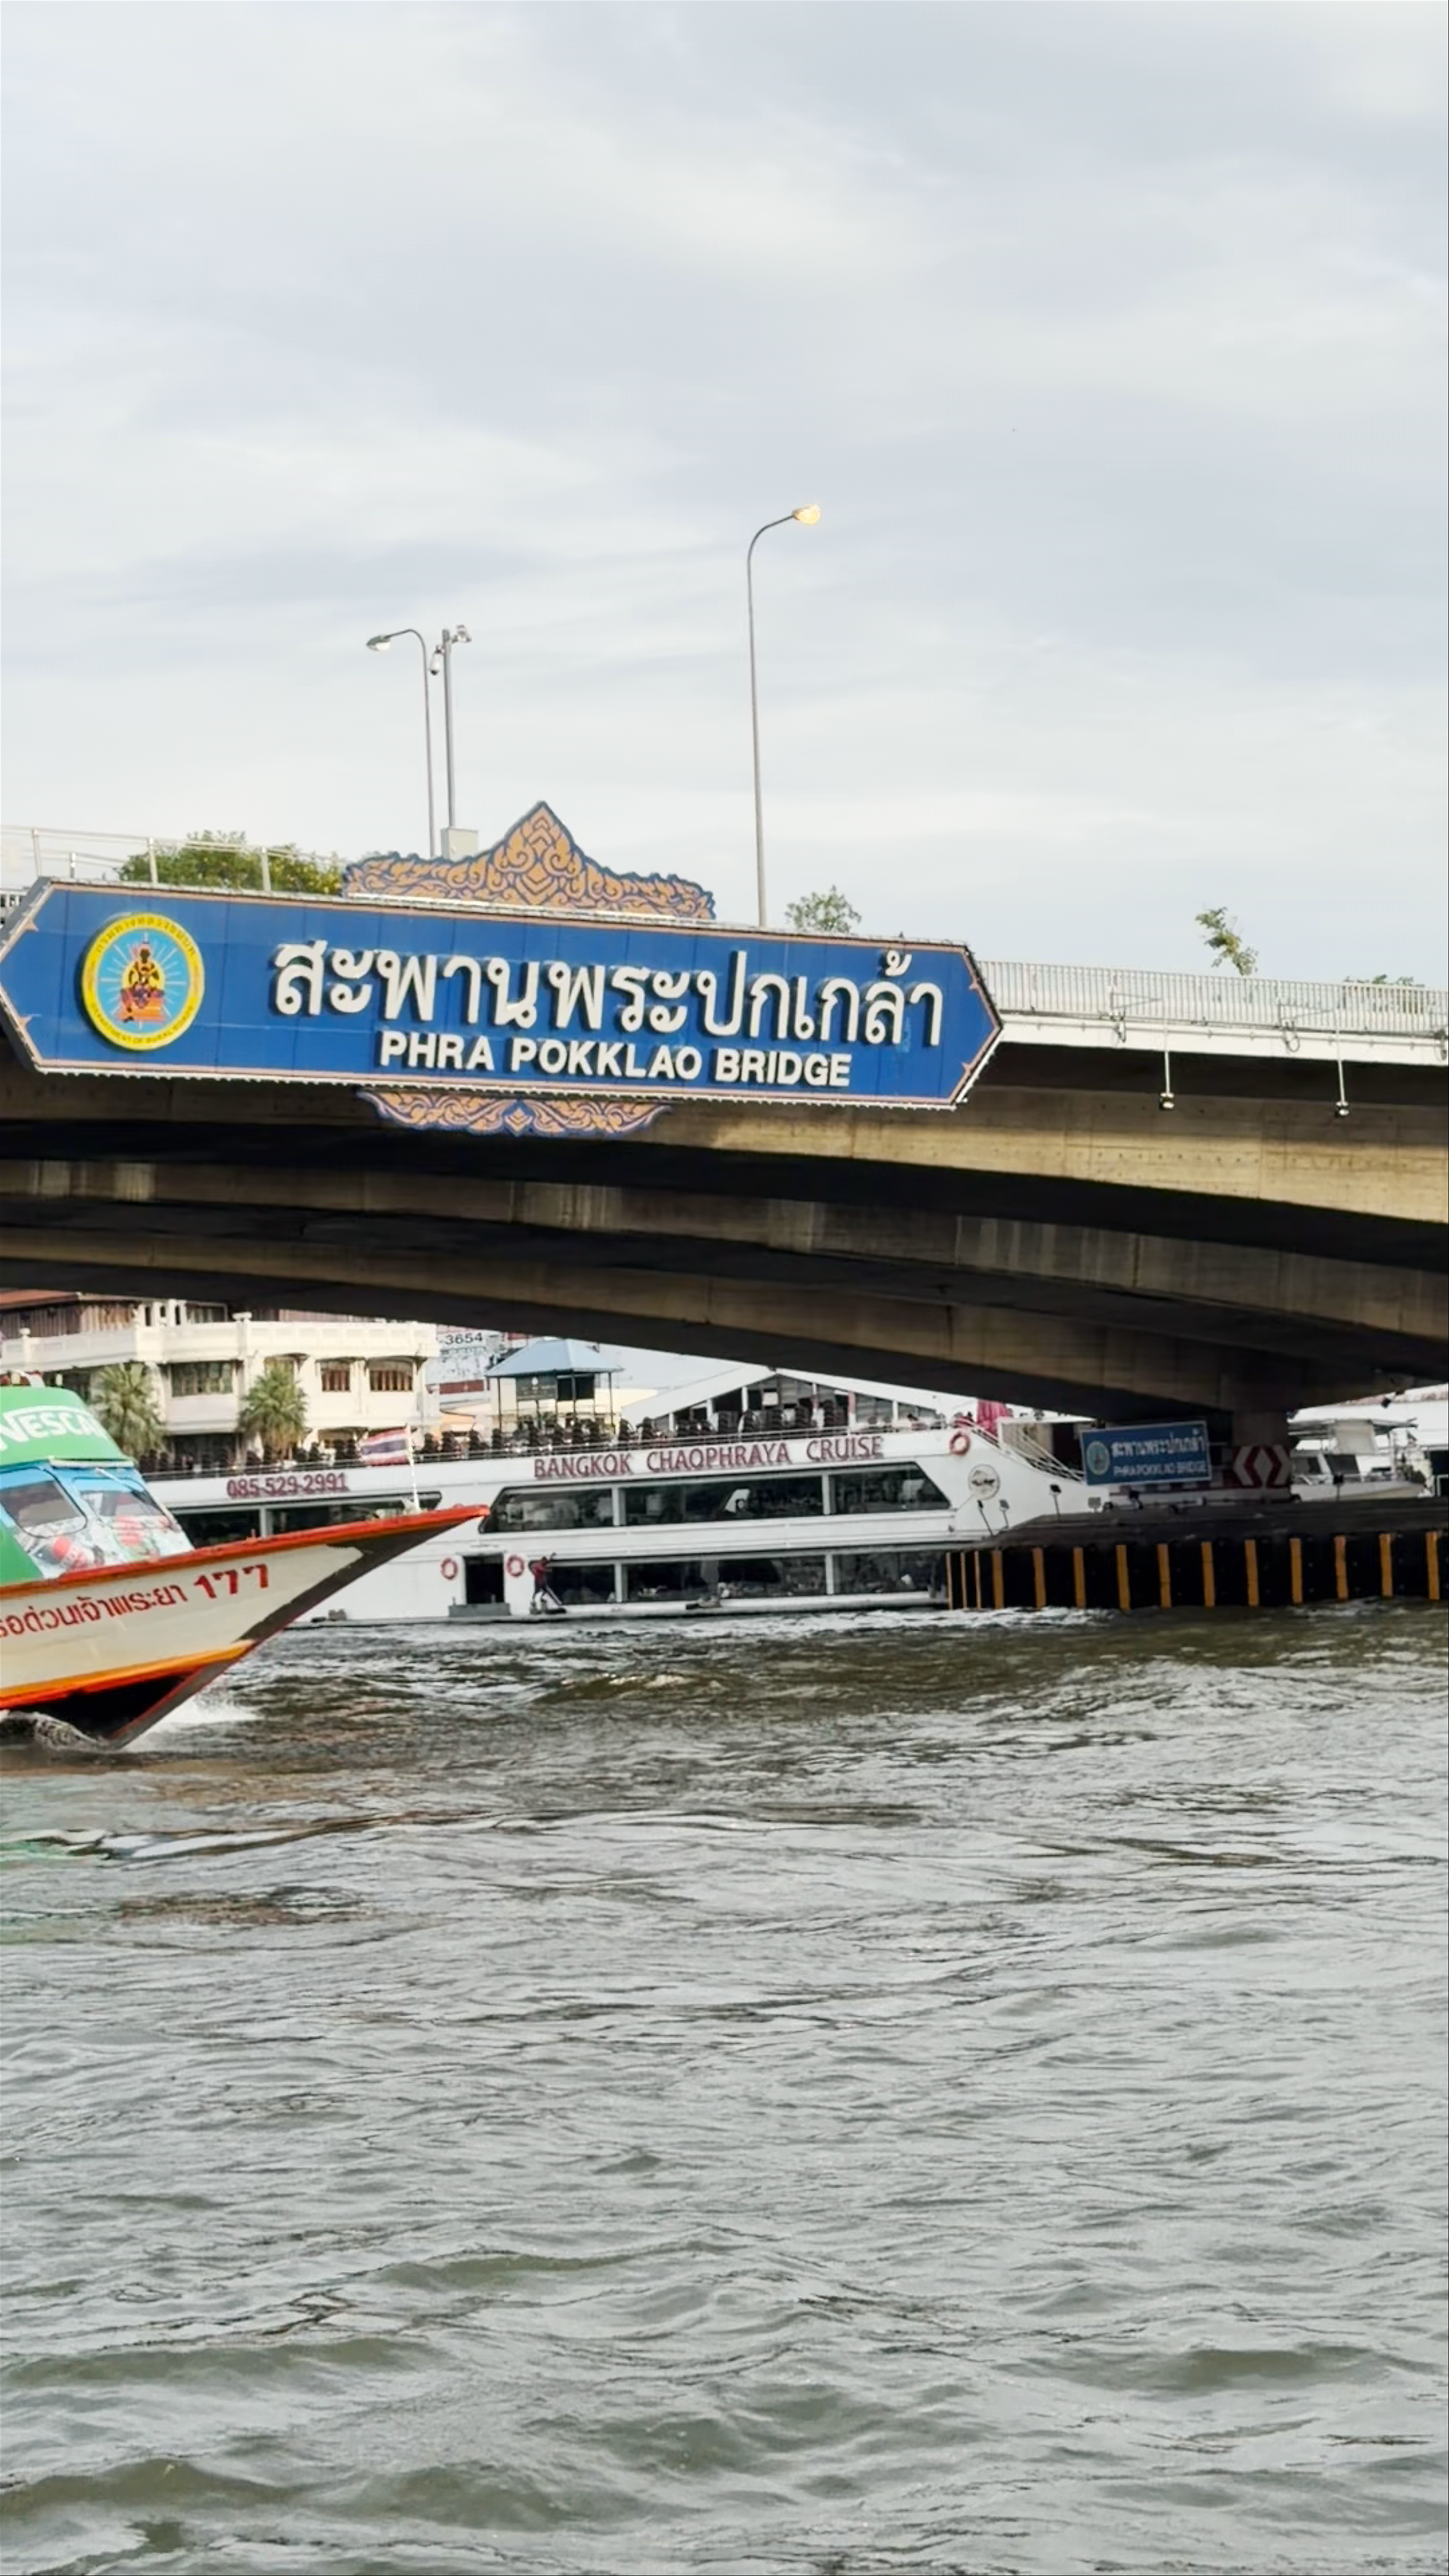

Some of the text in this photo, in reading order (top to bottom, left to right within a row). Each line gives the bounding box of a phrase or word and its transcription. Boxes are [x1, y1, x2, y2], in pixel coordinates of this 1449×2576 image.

[275, 940, 943, 1046] สะพานพระปกเกล้า
[380, 1031, 852, 1087] PHRA POKKLAO BRIDGE
[534, 1436, 884, 1478] BANGKOK CHAOPHRAYA CRUISE
[194, 1564, 269, 1599] 177
